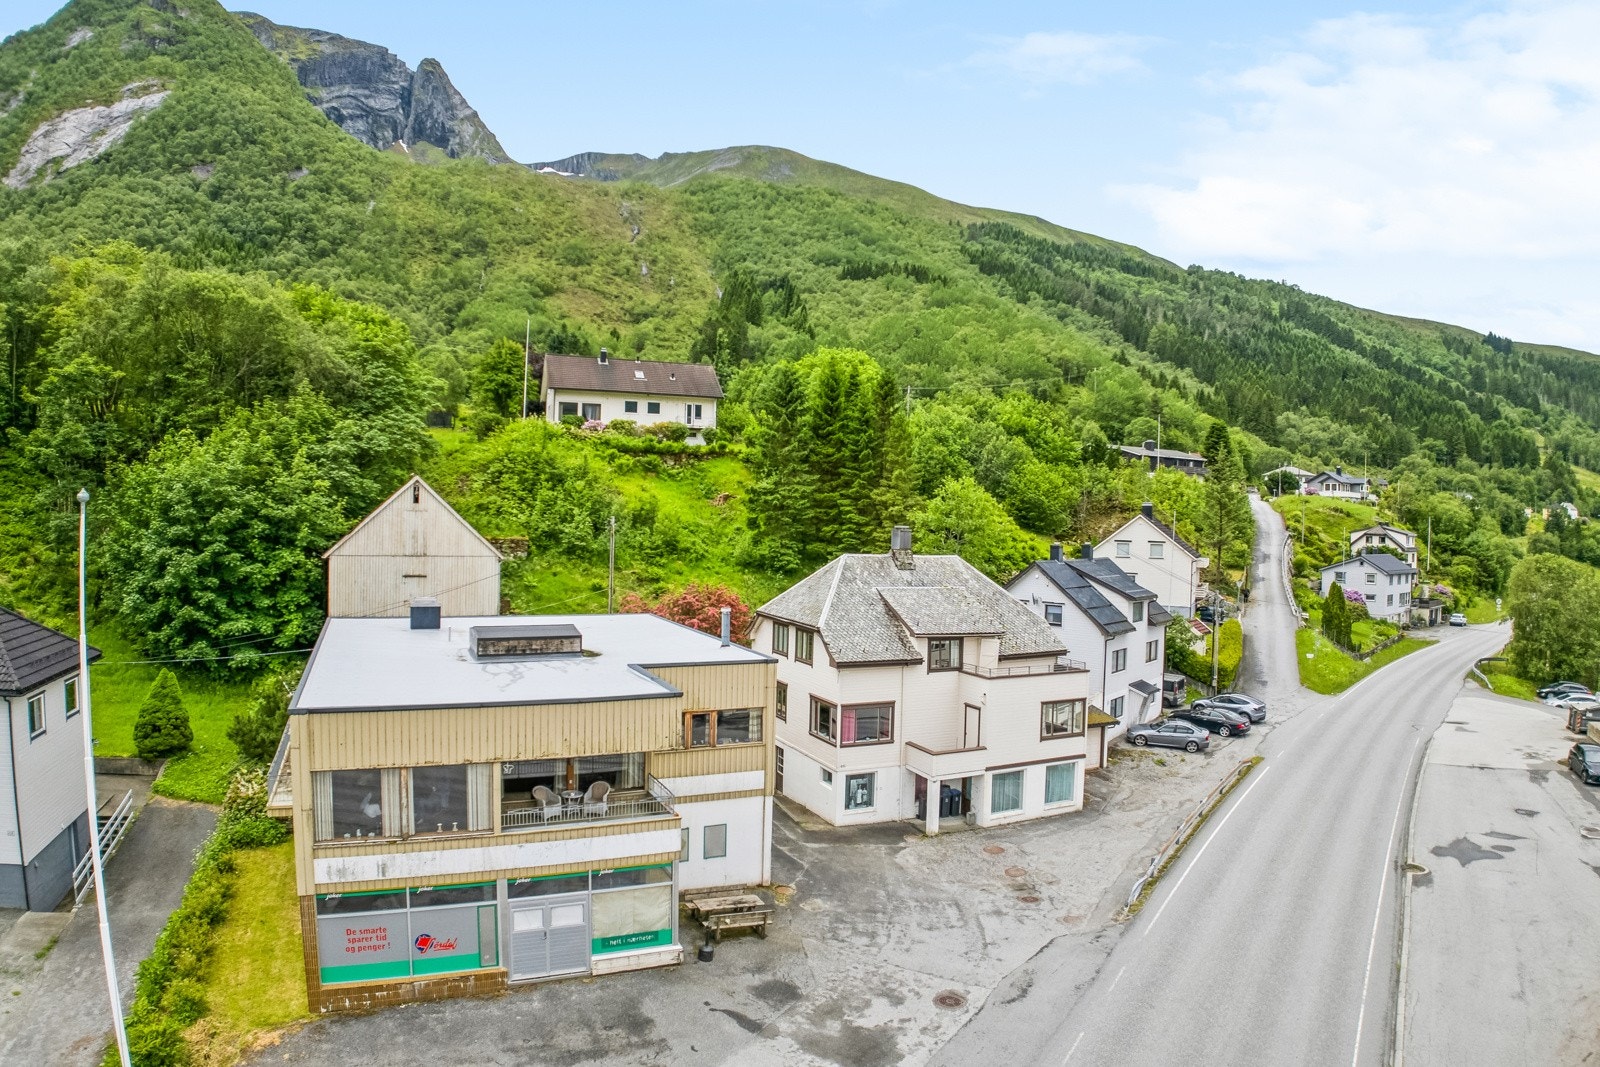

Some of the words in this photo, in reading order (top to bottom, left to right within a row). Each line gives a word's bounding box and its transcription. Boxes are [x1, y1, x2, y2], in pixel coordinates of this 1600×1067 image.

[417, 886, 434, 894] joker
[346, 928, 356, 936] De
[359, 926, 387, 935] smarte
[347, 936, 373, 944] sparer
[345, 946, 356, 954] og
[357, 944, 385, 953] penger
